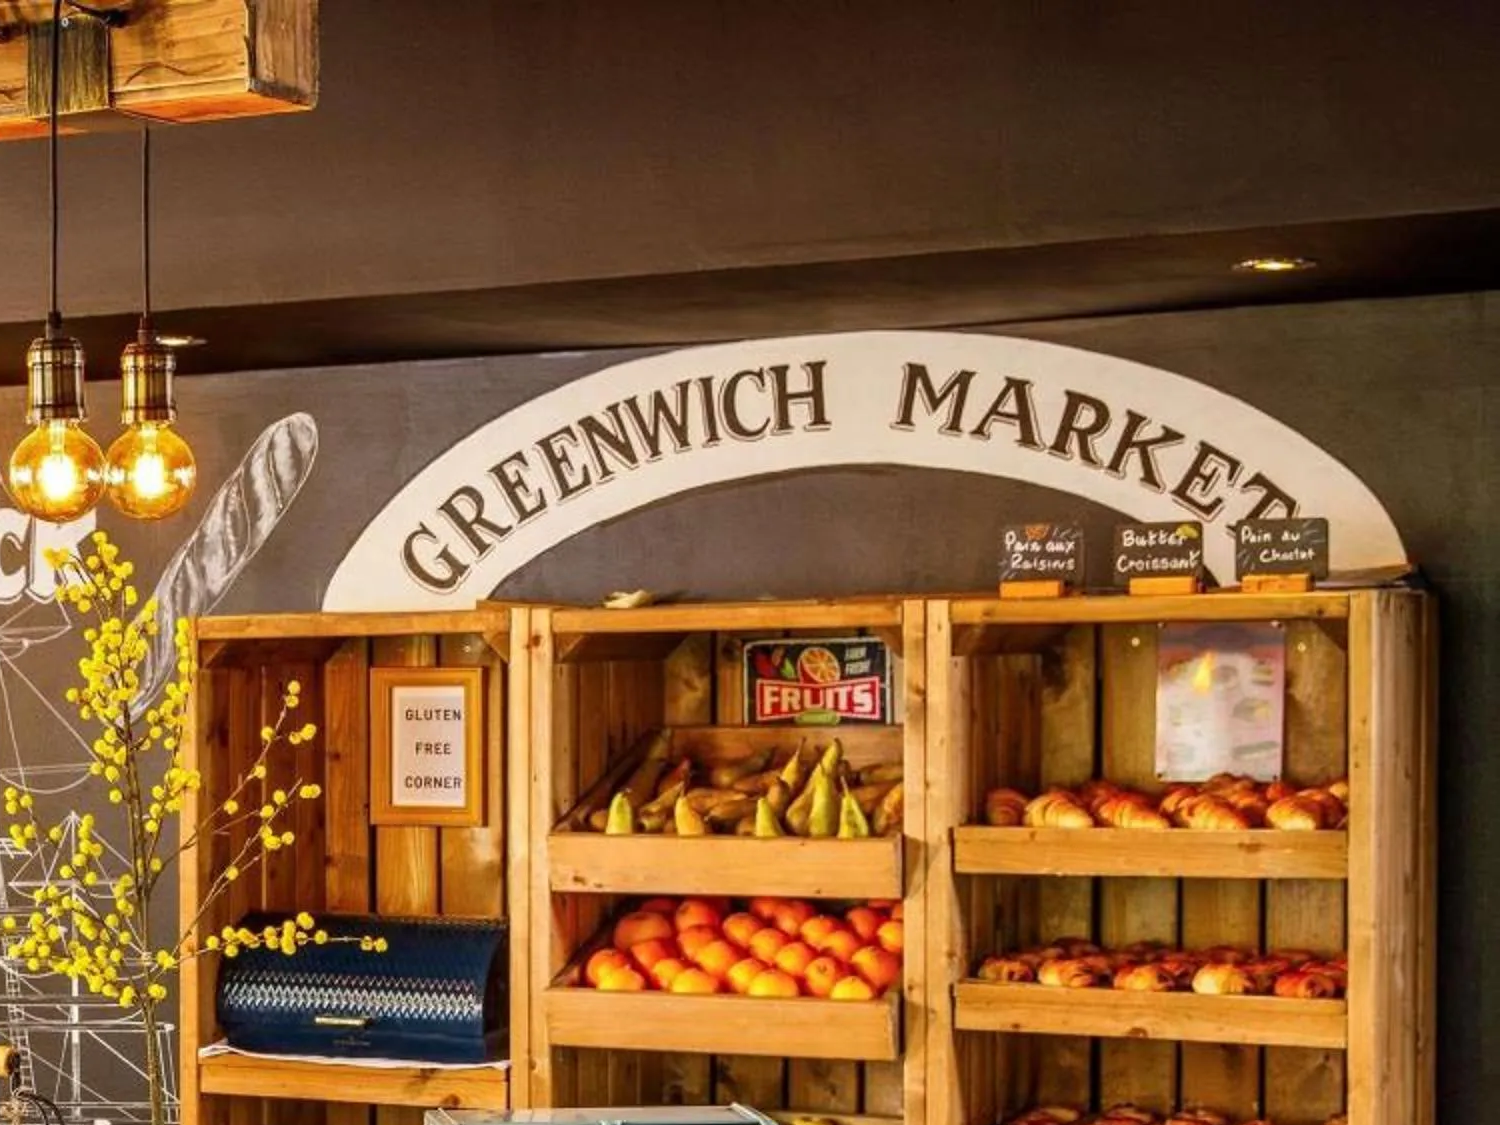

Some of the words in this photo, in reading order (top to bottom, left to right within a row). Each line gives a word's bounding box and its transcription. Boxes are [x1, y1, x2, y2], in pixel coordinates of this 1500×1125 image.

[401, 360, 832, 594] GREENWICH
[1241, 525, 1272, 544] Pain
[1281, 530, 1301, 542] au
[1116, 551, 1200, 572] Croissant
[763, 683, 874, 715] FRUITS
[404, 708, 462, 721] GLUTEN
[415, 741, 452, 755] FREE
[404, 776, 462, 790] CORNER
